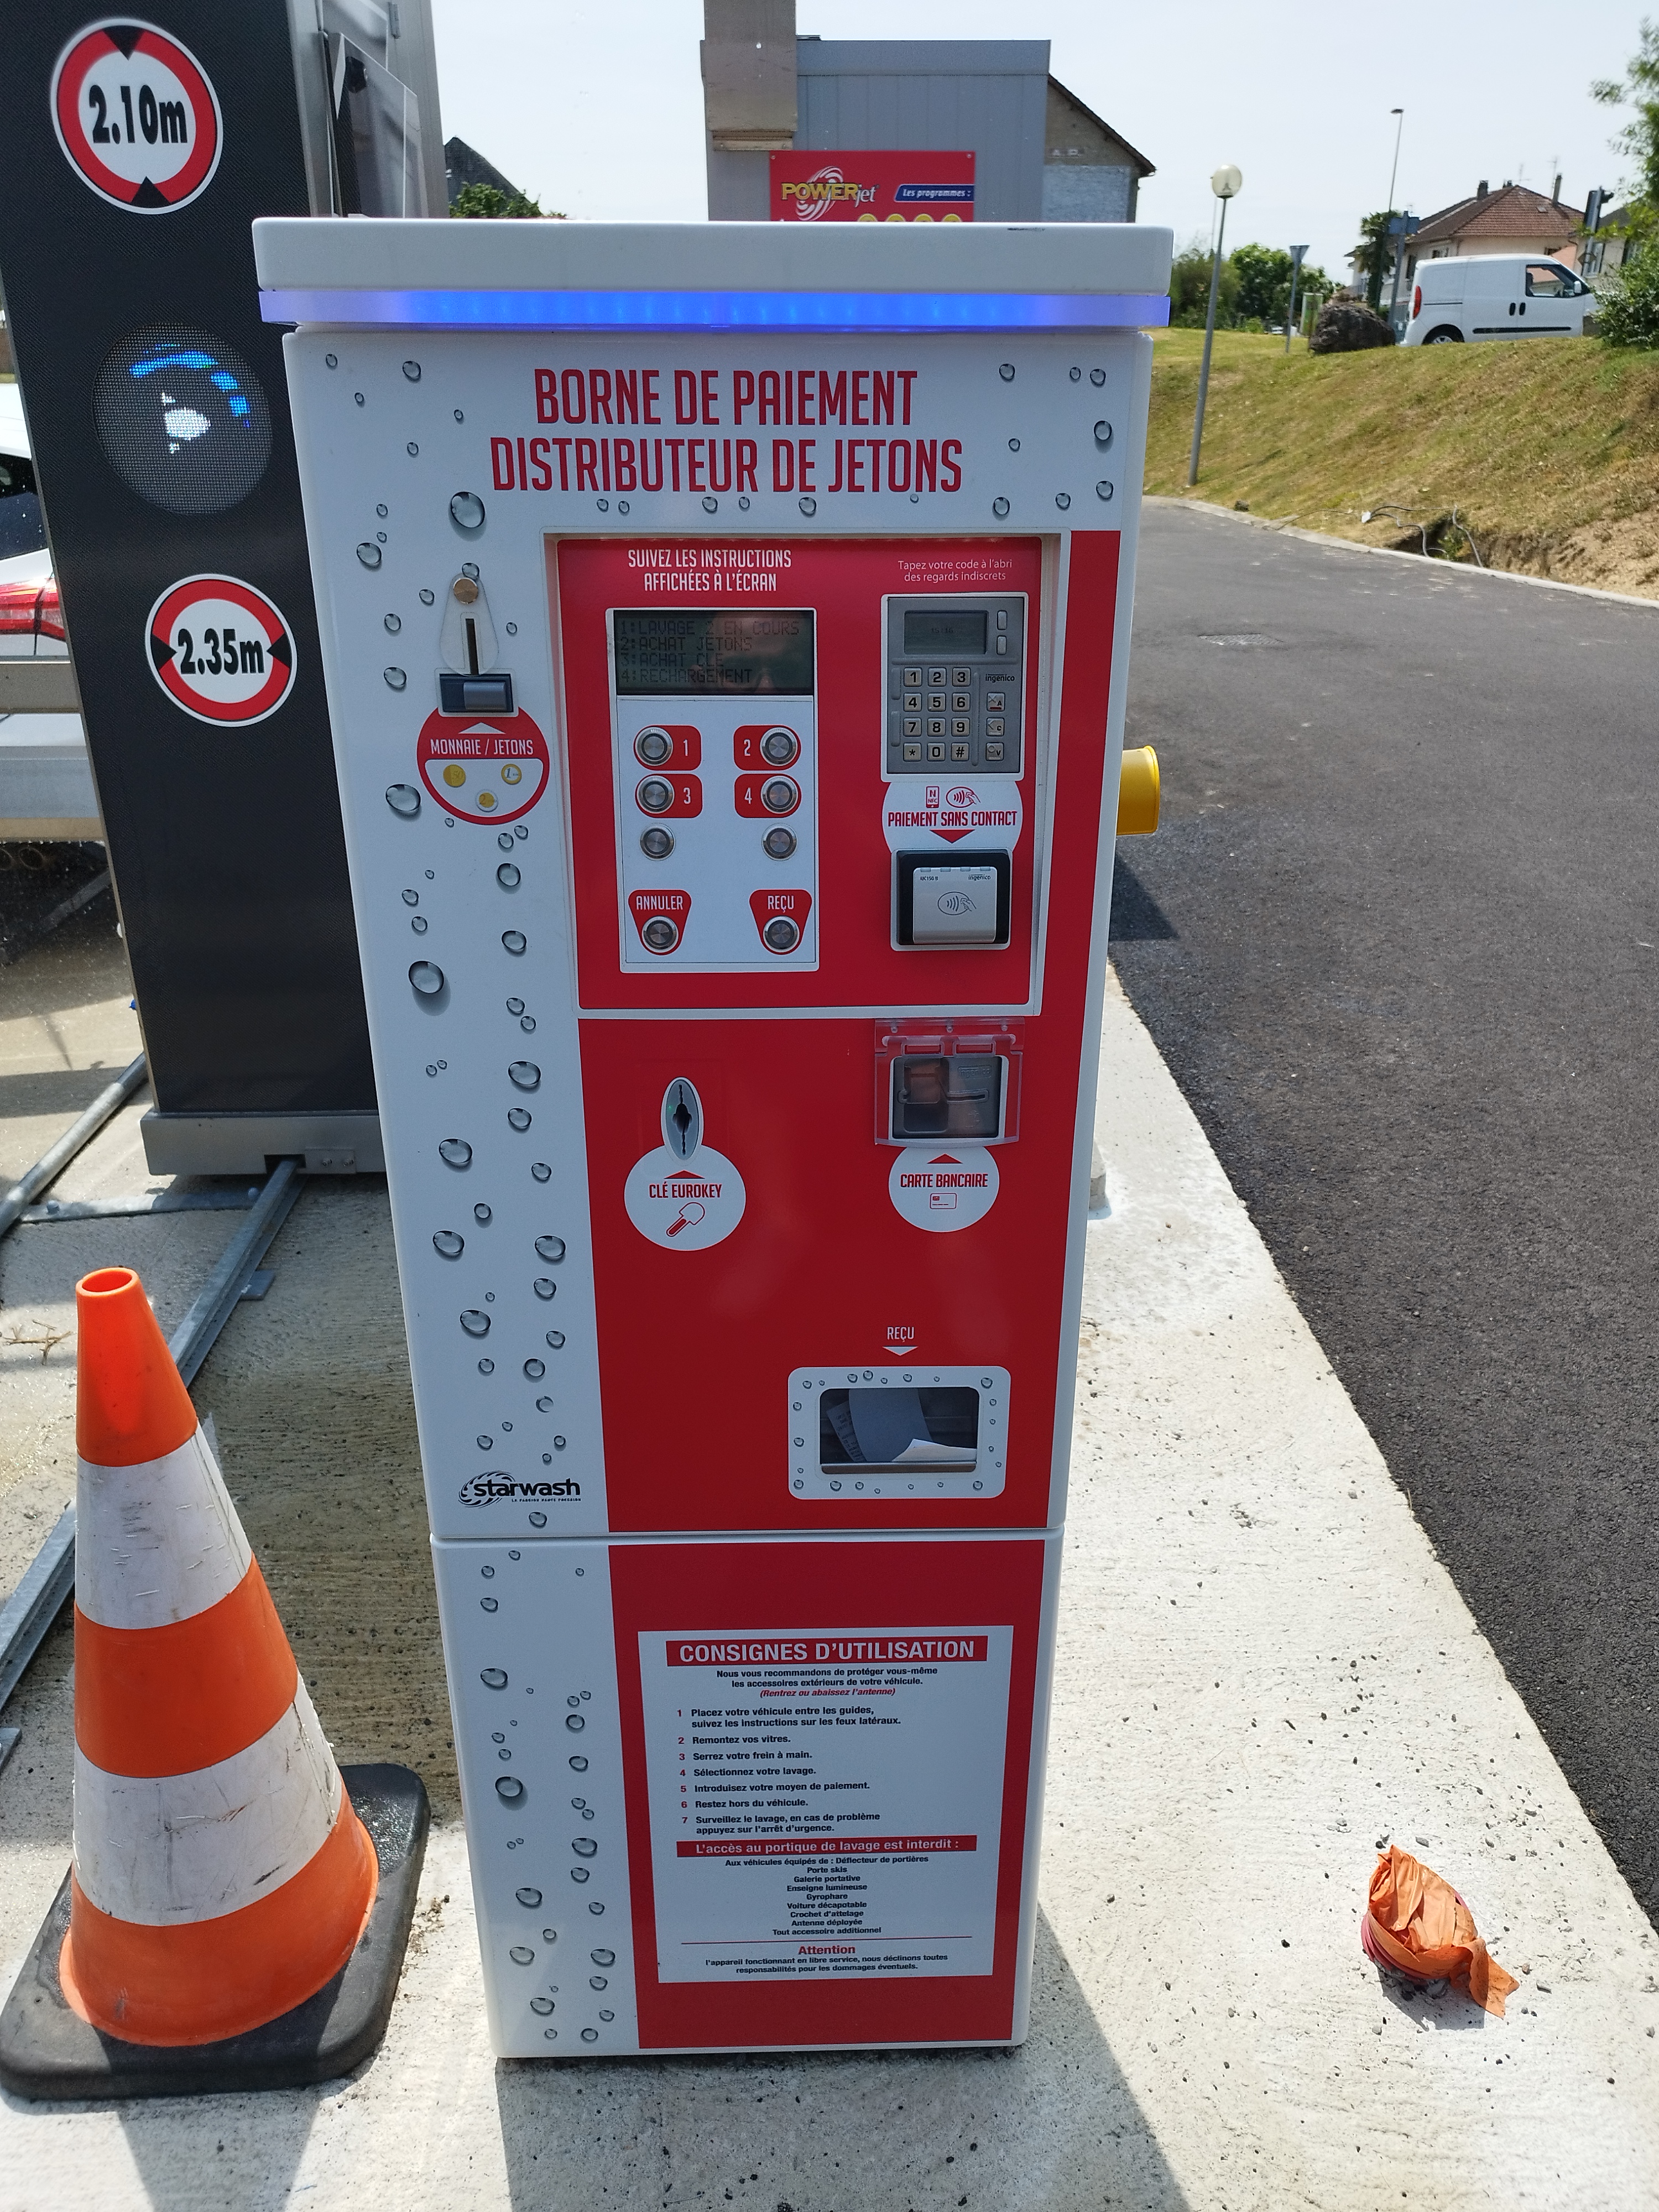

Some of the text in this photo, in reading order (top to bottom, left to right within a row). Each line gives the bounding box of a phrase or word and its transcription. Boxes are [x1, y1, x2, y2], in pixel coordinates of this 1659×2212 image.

[89, 85, 187, 144] 2.10m
[902, 189, 916, 197] Les
[918, 189, 965, 199] programmes
[535, 368, 917, 426] BORNE DE PAIEMENT
[491, 437, 962, 493] DISTRIBUTEUR DE JETONS
[629, 550, 791, 567] SUIVEZ LES INSTRUCTIONS
[898, 559, 1011, 572] Tapez votre code à l'abri
[645, 570, 776, 591] AFFICHÉES À L'ÉCRAN
[905, 571, 1005, 583] des regards indiscrets
[753, 620, 800, 635] COURS
[696, 637, 753, 651] JETONS
[178, 628, 264, 675] 2.35m
[910, 671, 966, 683] 1 2 3
[985, 673, 1015, 682] ingenico
[908, 696, 966, 708] 4 5 6
[908, 721, 965, 733] 7 8 9
[431, 739, 481, 755] MONNAIE
[494, 740, 533, 755] JETONS
[683, 739, 751, 757] 1 2
[684, 787, 752, 805] 3 4
[888, 811, 1018, 827] PAIEMENT SANS CONTACT
[636, 895, 684, 910] ANNULER
[767, 895, 795, 913] REÇU
[901, 1173, 988, 1187] CARTE BANCAIRE
[649, 1181, 722, 1198] CLÉ EUROKEY
[888, 1327, 914, 1342] REÇU
[473, 1478, 581, 1496] starwash
[680, 1641, 973, 1662] CONSIGNES D'UTILISATION
[764, 1669, 831, 1677] recommandons
[847, 1668, 884, 1677] protéger
[760, 1690, 796, 1698] (Rentrez
[852, 1688, 895, 1696] l'antenne)
[753, 1707, 792, 1715] véhicule
[839, 1706, 874, 1715] guides,
[778, 1751, 782, 1759] à
[694, 1768, 753, 1777] Sélectionnez
[784, 1767, 816, 1776] lavage.
[695, 1784, 747, 1792] Introduisez
[824, 1782, 869, 1791] paiement.
[696, 1815, 741, 1824] Surveillez
[755, 1815, 787, 1823] lavage,
[837, 1812, 880, 1822] problème
[786, 1824, 834, 1833] d'urgence.
[696, 1843, 743, 1854] L'accès
[746, 1844, 761, 1853] au
[765, 1841, 817, 1855] portique
[821, 1841, 836, 1852] de
[839, 1840, 880, 1854] lavage
[884, 1840, 903, 1850] est
[906, 1839, 952, 1850] interdit
[825, 1875, 860, 1884] portative
[818, 1901, 867, 1910] décapotable
[799, 1945, 855, 1955] Attention
